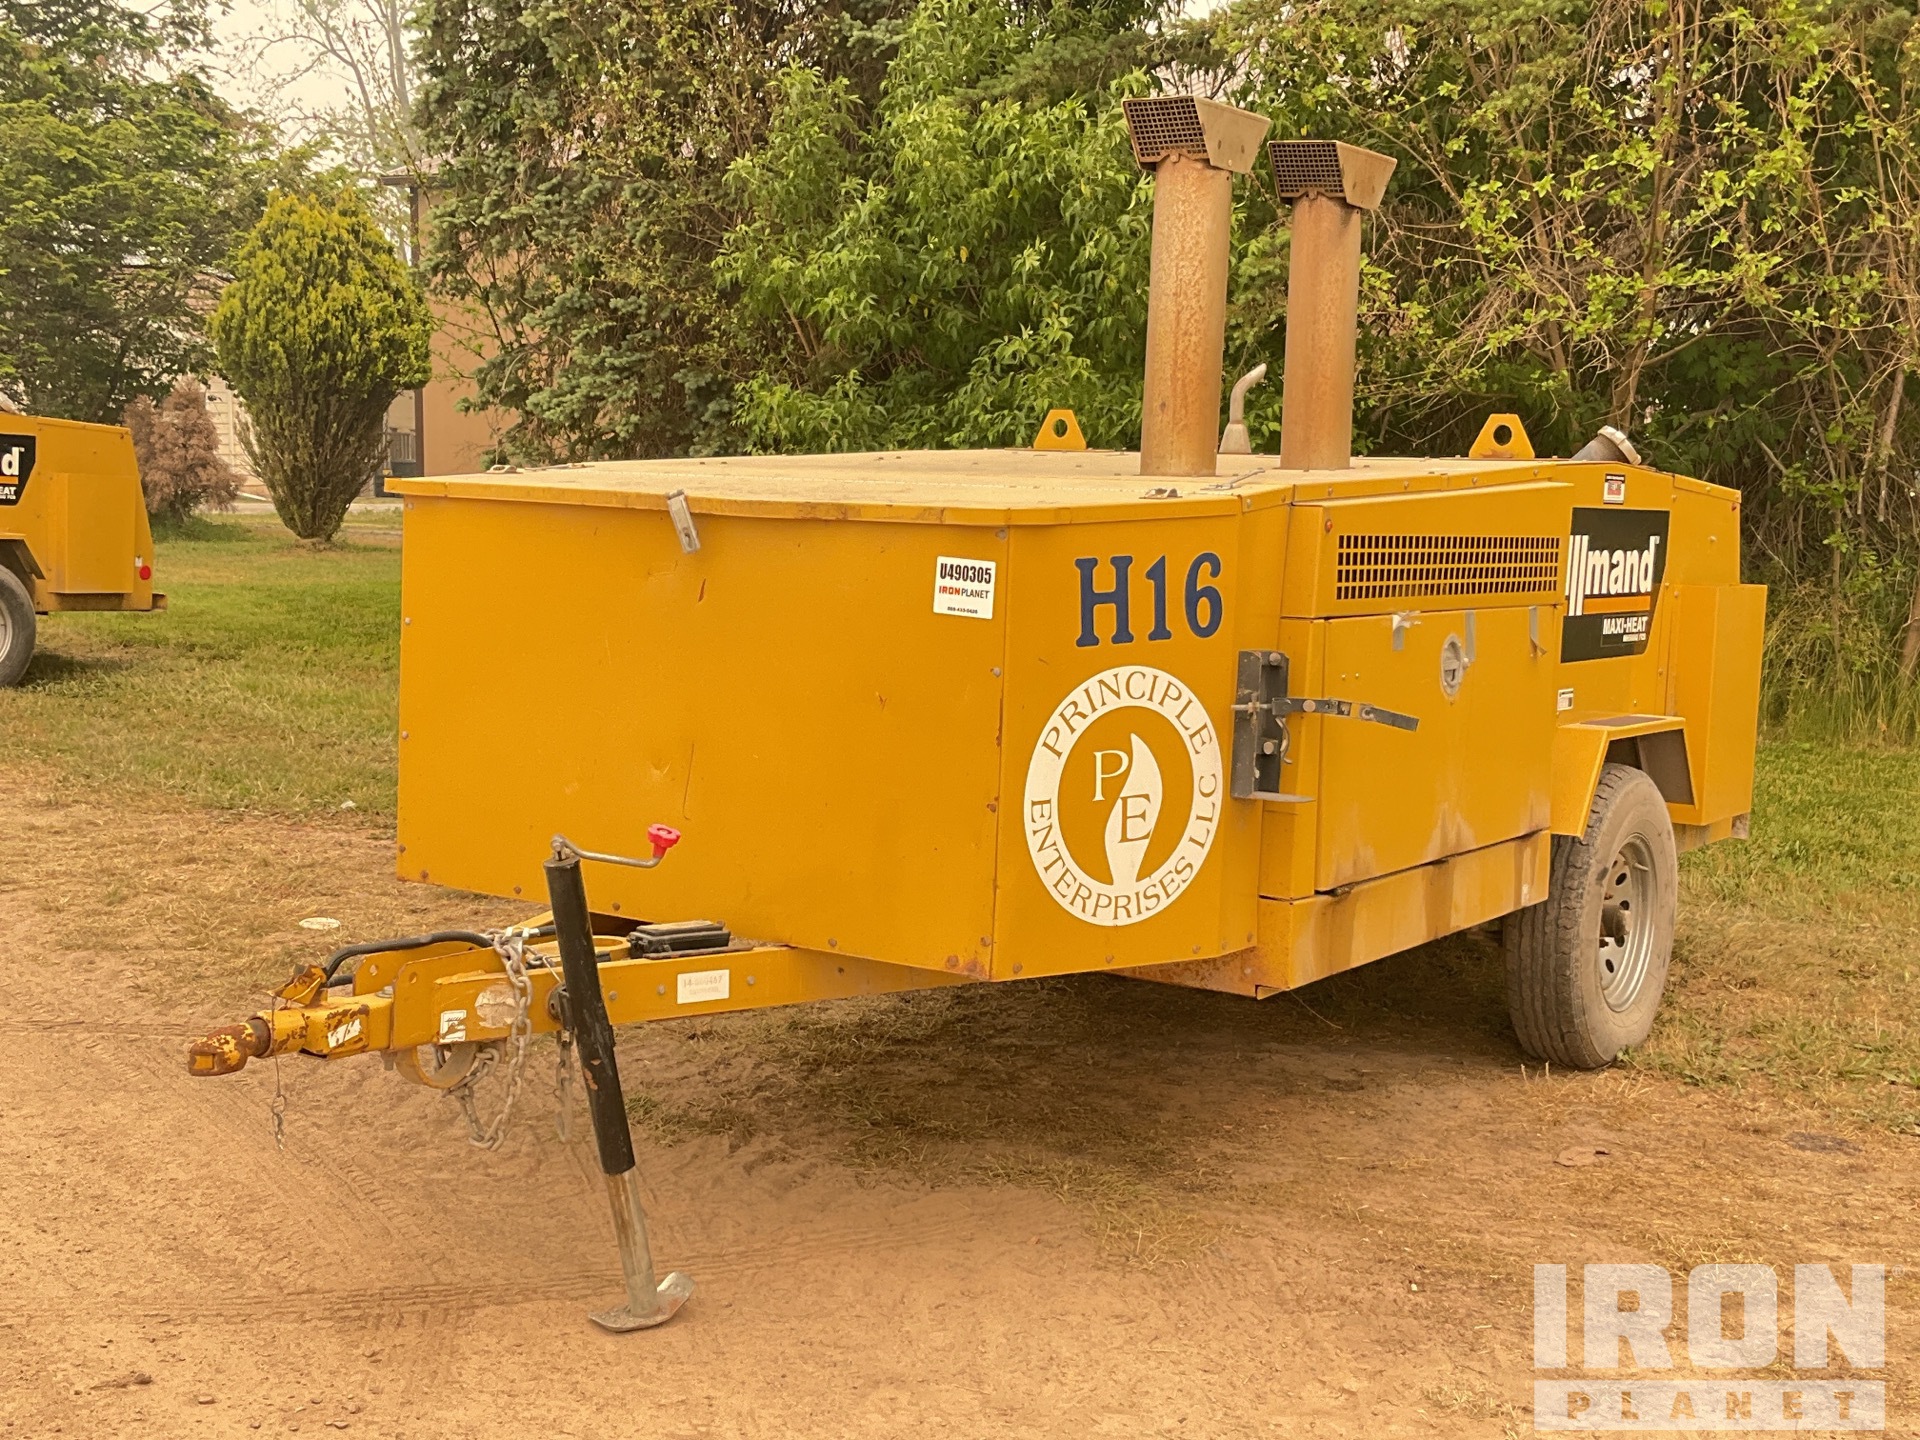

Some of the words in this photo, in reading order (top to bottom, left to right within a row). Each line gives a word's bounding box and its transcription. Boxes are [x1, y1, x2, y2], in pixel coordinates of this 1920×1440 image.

[940, 563, 992, 585] U490305
[1075, 552, 1222, 647] H16
[1602, 616, 1649, 635] MAXI-HEAT
[1041, 671, 1212, 760] PRINCIPLE
[1030, 798, 1194, 920] ENTERPRISES
[1188, 773, 1217, 850] LLC
